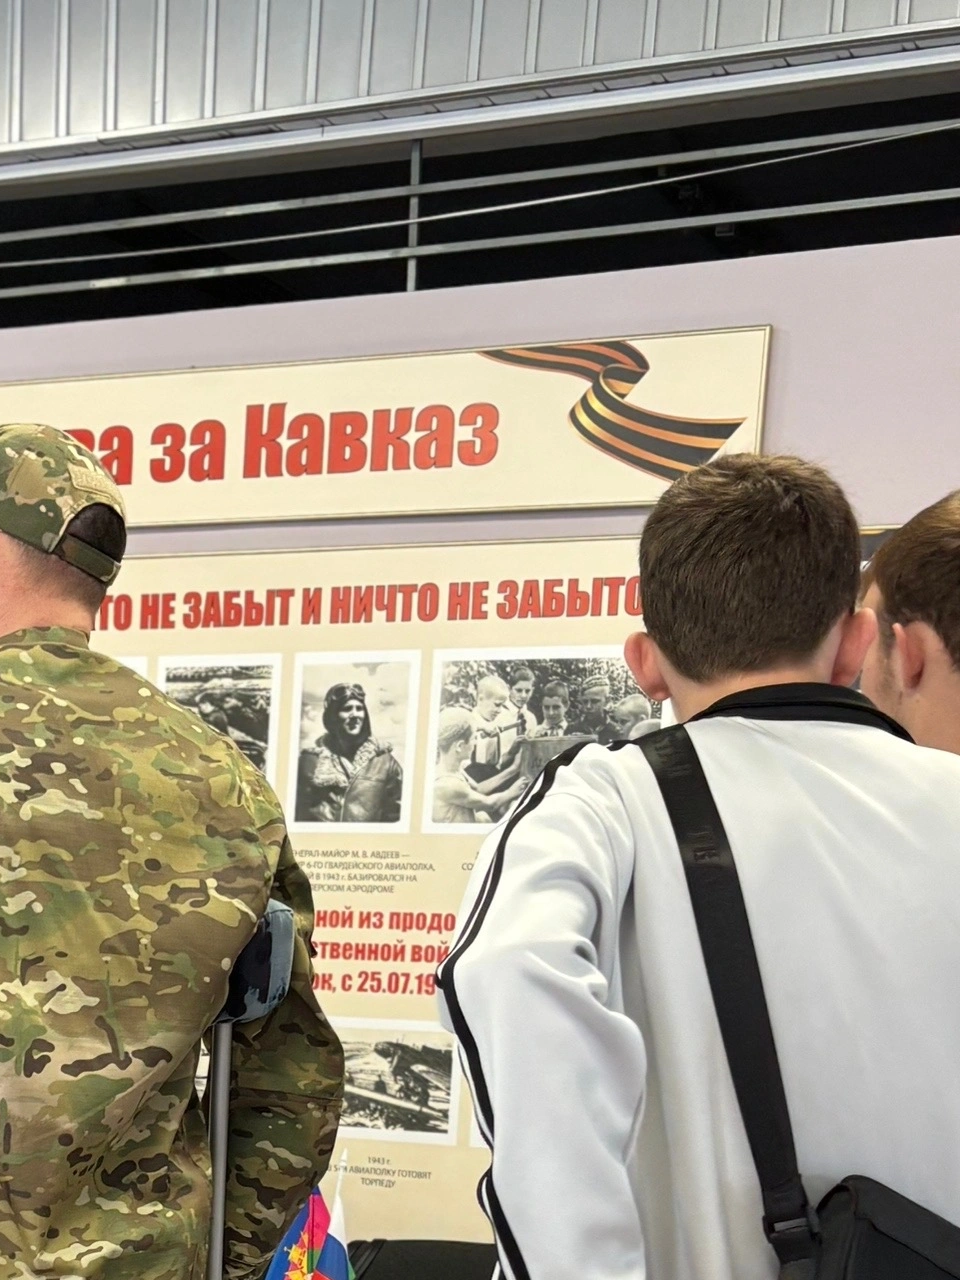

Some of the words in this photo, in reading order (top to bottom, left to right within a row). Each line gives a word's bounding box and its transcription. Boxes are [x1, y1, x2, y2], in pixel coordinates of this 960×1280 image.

[150, 419, 226, 482] за
[243, 402, 500, 479] Кавказ
[92, 594, 132, 631] ТО
[140, 593, 176, 630] НЕ
[182, 588, 295, 629] ЗАБЫТ
[301, 587, 323, 625] И
[329, 583, 439, 624] НИЧТО
[447, 581, 489, 621] НЕ
[496, 576, 643, 620] ЗАБЫТО
[306, 862, 323, 870] 6-ГО
[325, 862, 383, 871] ГВАРДЕЙСКОГО
[384, 863, 436, 872] АВИАПОЛКА,
[322, 873, 339, 881] 1943
[347, 874, 404, 882] БАЗИРОВАЛСЯ
[346, 885, 394, 894] АЭРОДРОМЕ
[315, 906, 353, 928] ной
[359, 911, 384, 929] из
[388, 912, 456, 934] продо
[410, 940, 450, 963] вой
[312, 973, 336, 993] ок,
[341, 974, 353, 992] с
[357, 971, 436, 996] 25.07.19
[368, 1157, 385, 1165] 1943
[349, 1166, 396, 1177] АВИАПОЛКУ
[398, 1170, 432, 1179] ГОТОВЯТ
[361, 1177, 396, 1188] ТОРПЕДУ
